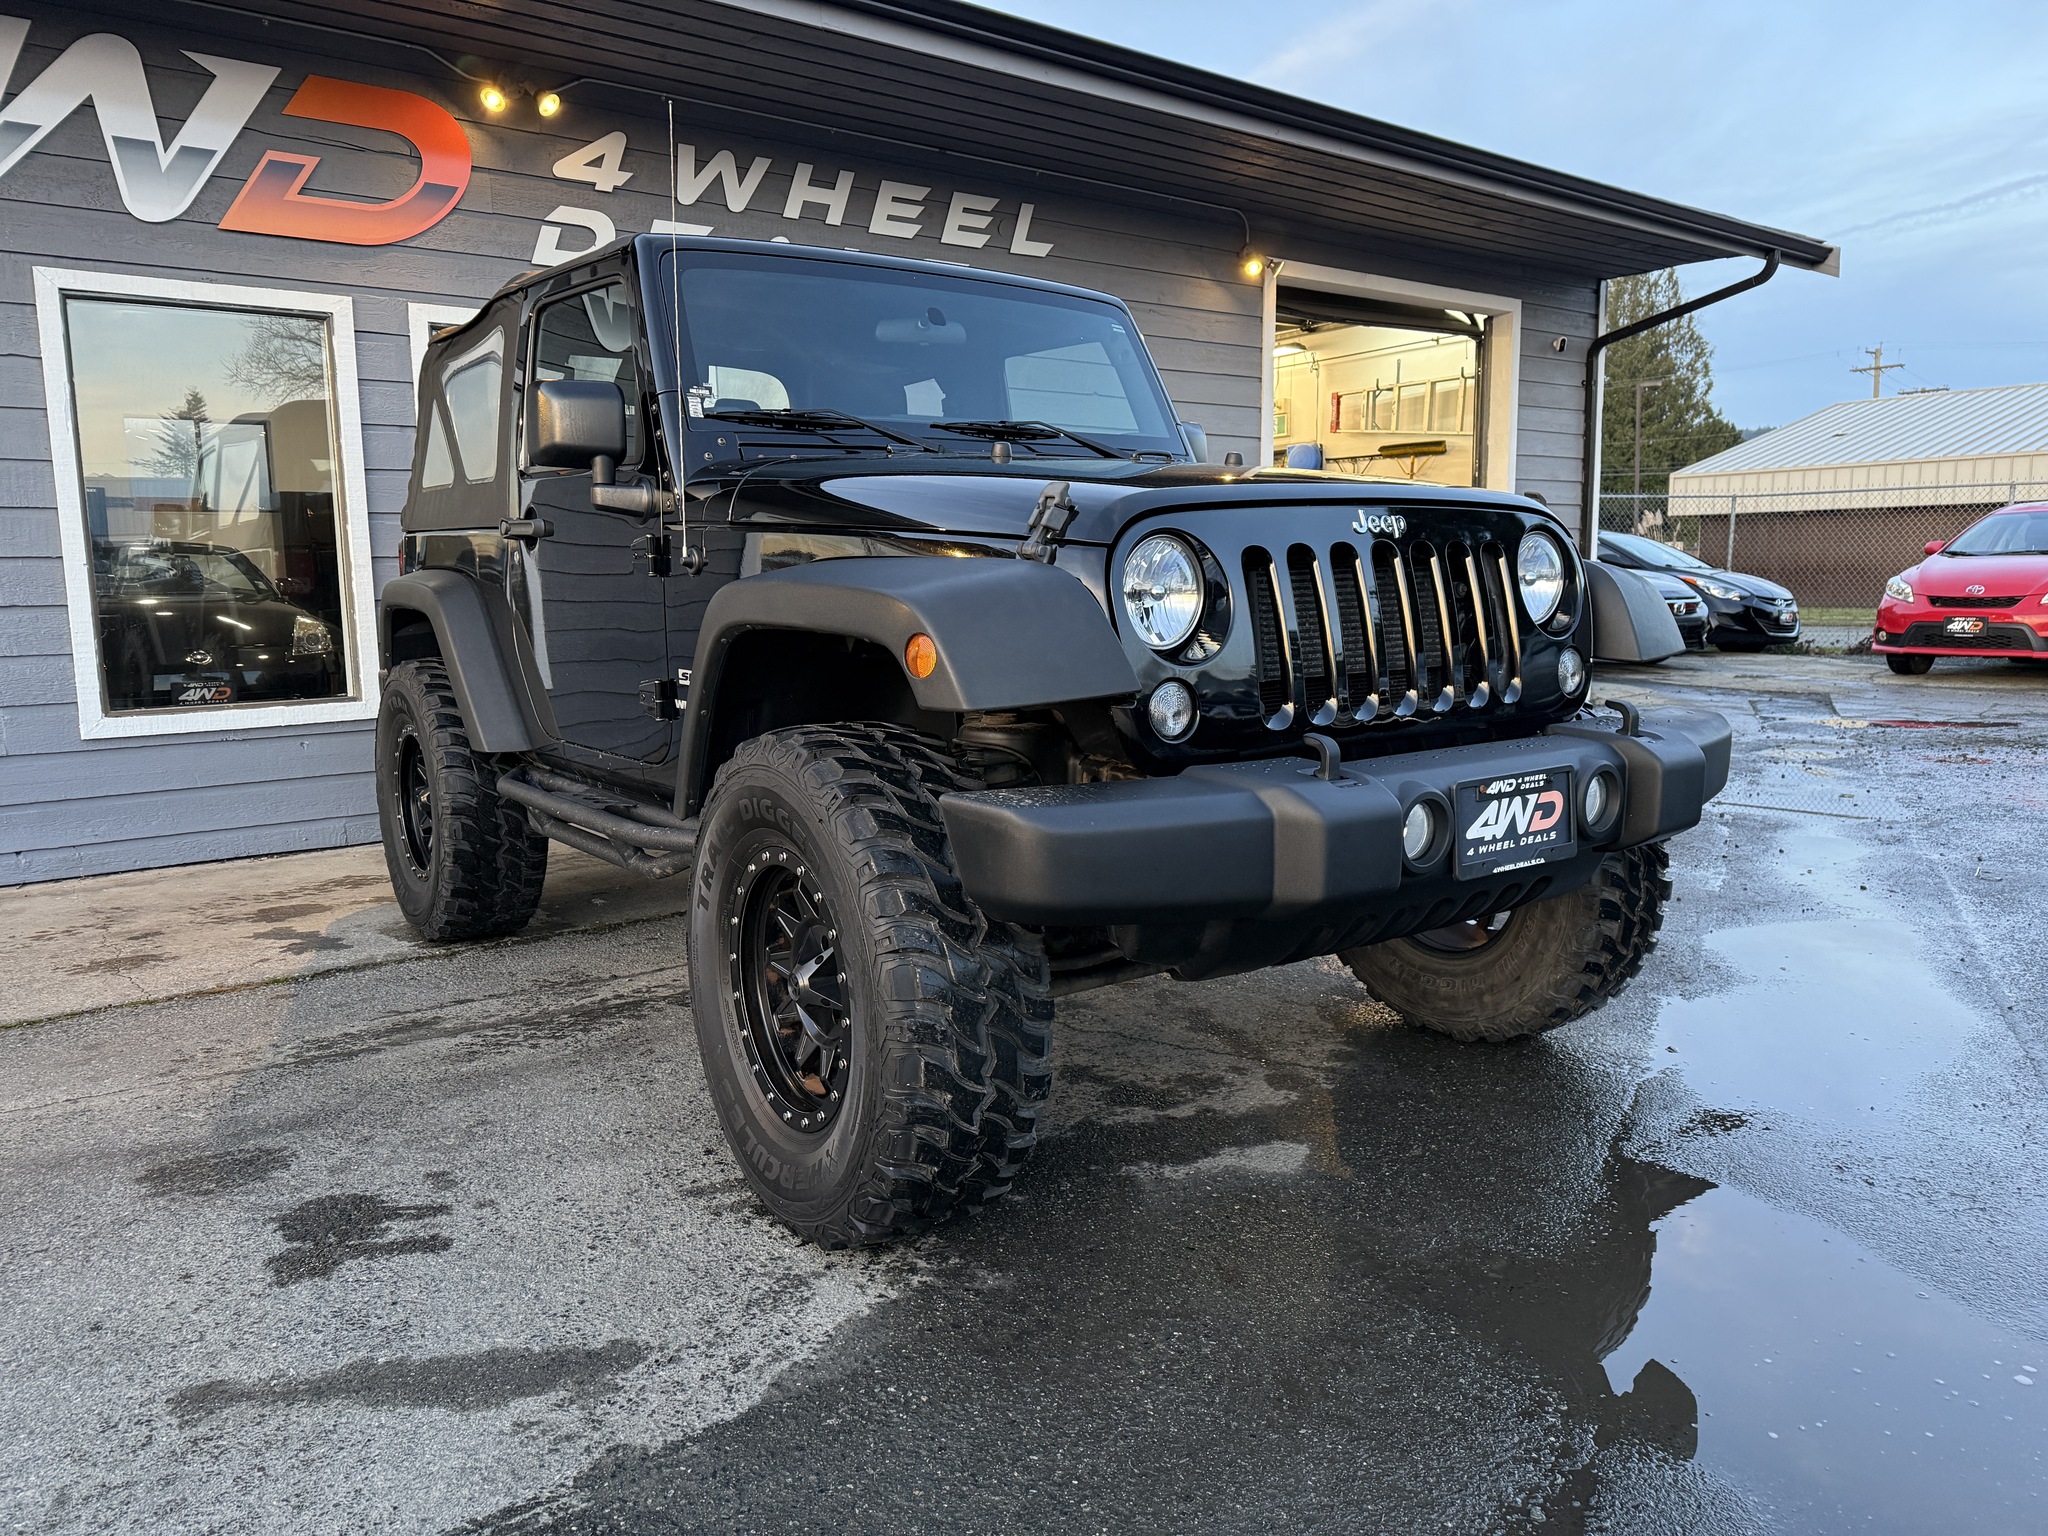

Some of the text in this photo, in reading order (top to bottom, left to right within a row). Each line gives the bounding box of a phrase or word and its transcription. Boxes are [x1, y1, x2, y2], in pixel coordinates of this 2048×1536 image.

[0, 15, 472, 246] WD
[552, 130, 633, 193] 4
[675, 142, 1055, 258] WHEEL
[1352, 509, 1407, 539] Jeep
[1947, 621, 1984, 630] 4WD
[178, 687, 232, 701] 4WD
[1486, 778, 1516, 794] 4WD
[1521, 781, 1544, 789] DEALS
[1525, 774, 1546, 782] WHEEL
[1466, 790, 1563, 841] 4WD
[1466, 831, 1556, 856] 4 WHEEL DEALS
[697, 819, 736, 912] TRAIL
[717, 1078, 824, 1190] HERCULES
